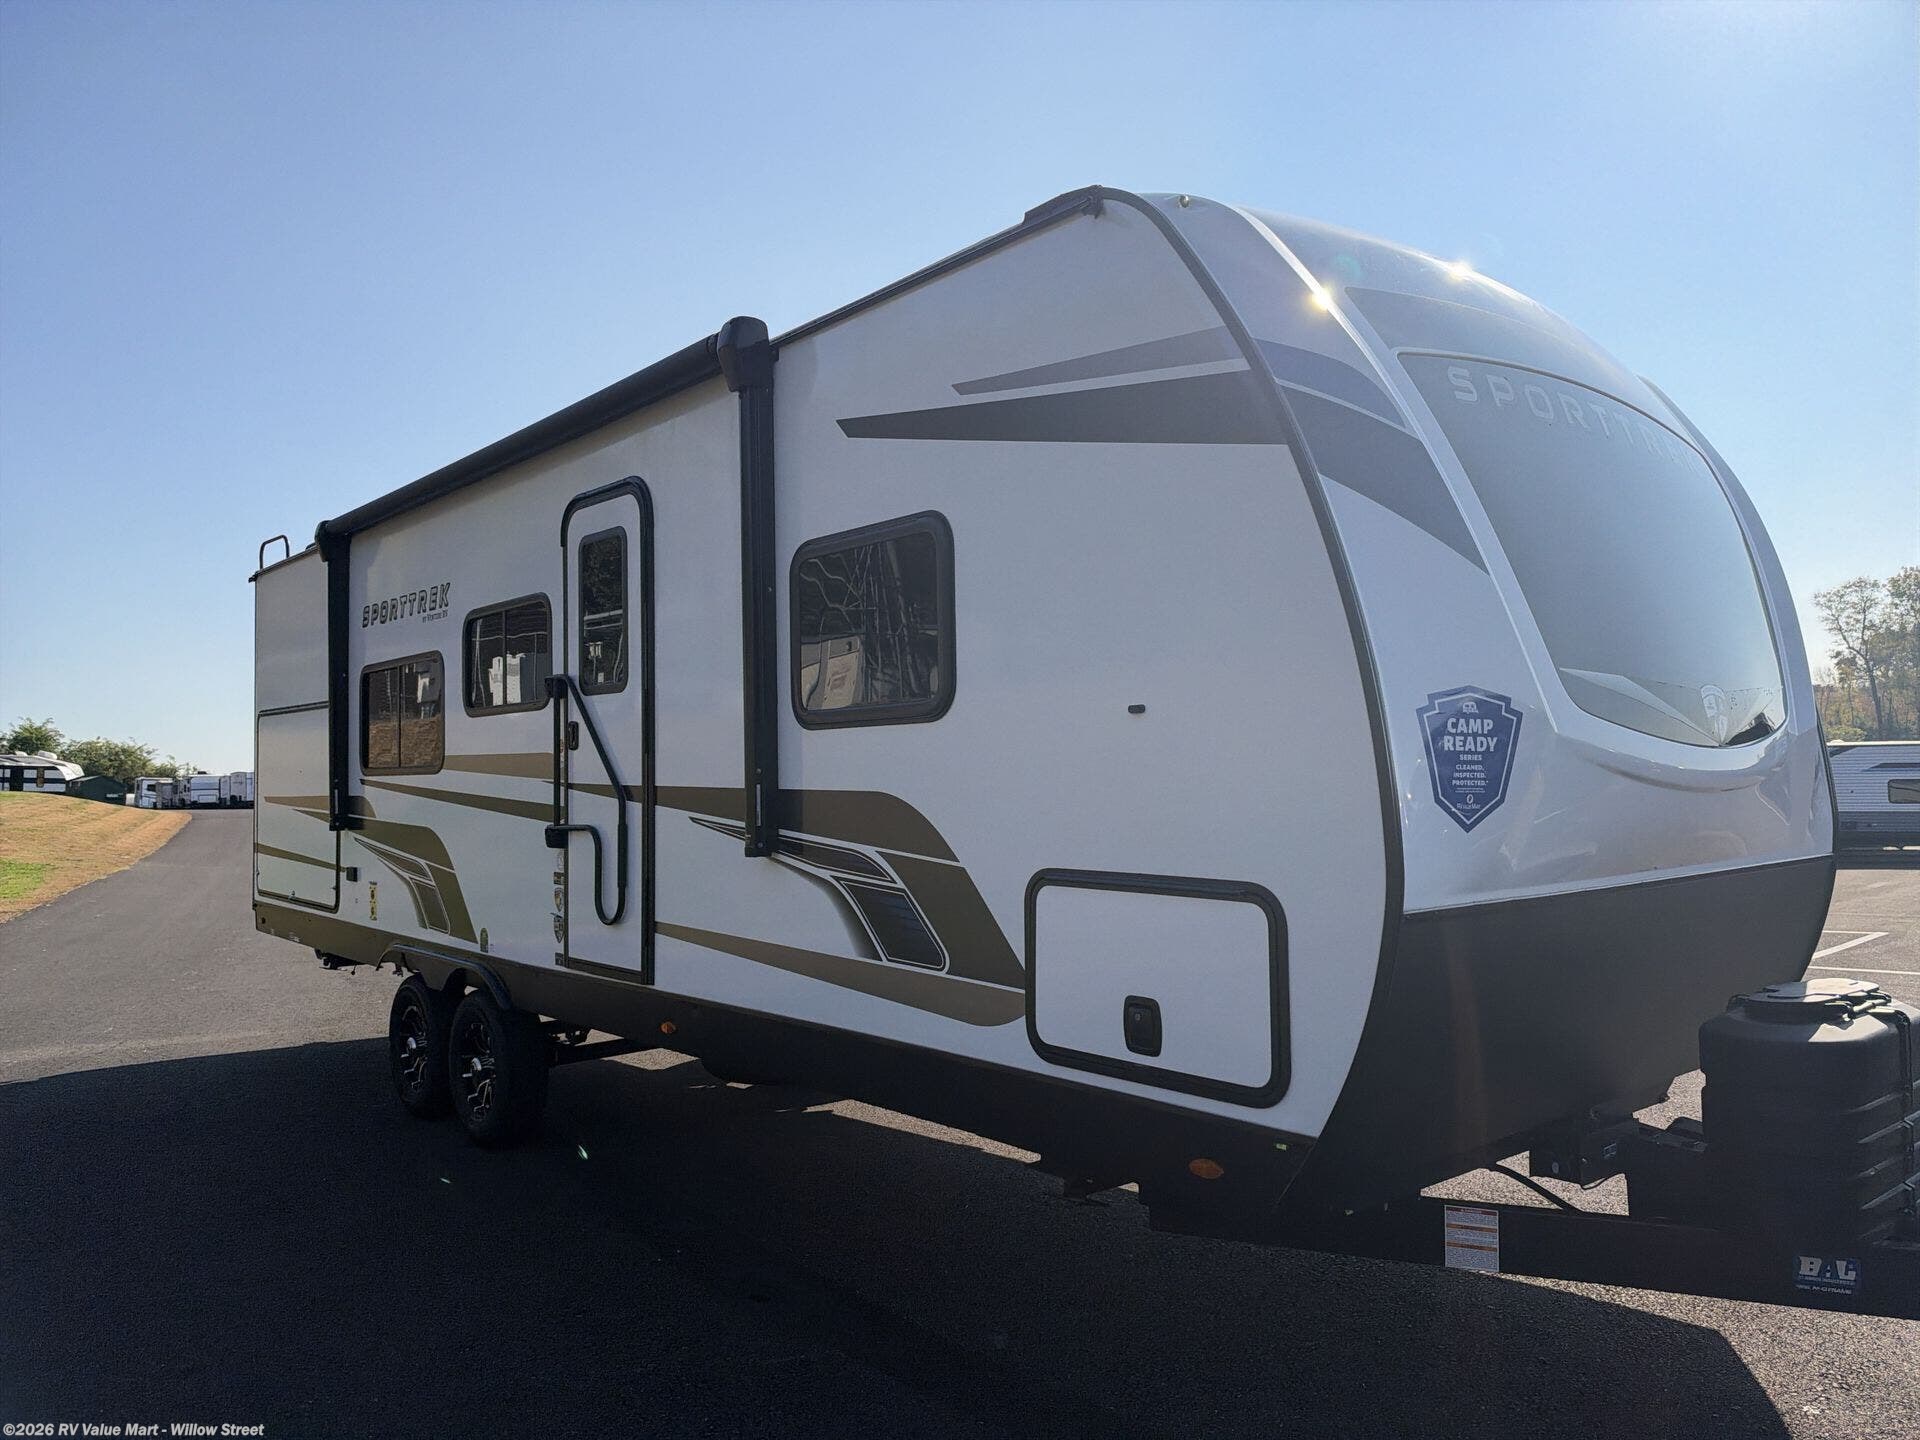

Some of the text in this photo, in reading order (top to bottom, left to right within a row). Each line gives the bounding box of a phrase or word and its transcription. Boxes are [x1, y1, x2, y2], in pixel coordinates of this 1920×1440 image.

[362, 582, 451, 628] SPORTTREK
[1447, 718, 1494, 734] CAMP
[1443, 735, 1498, 752] READY
